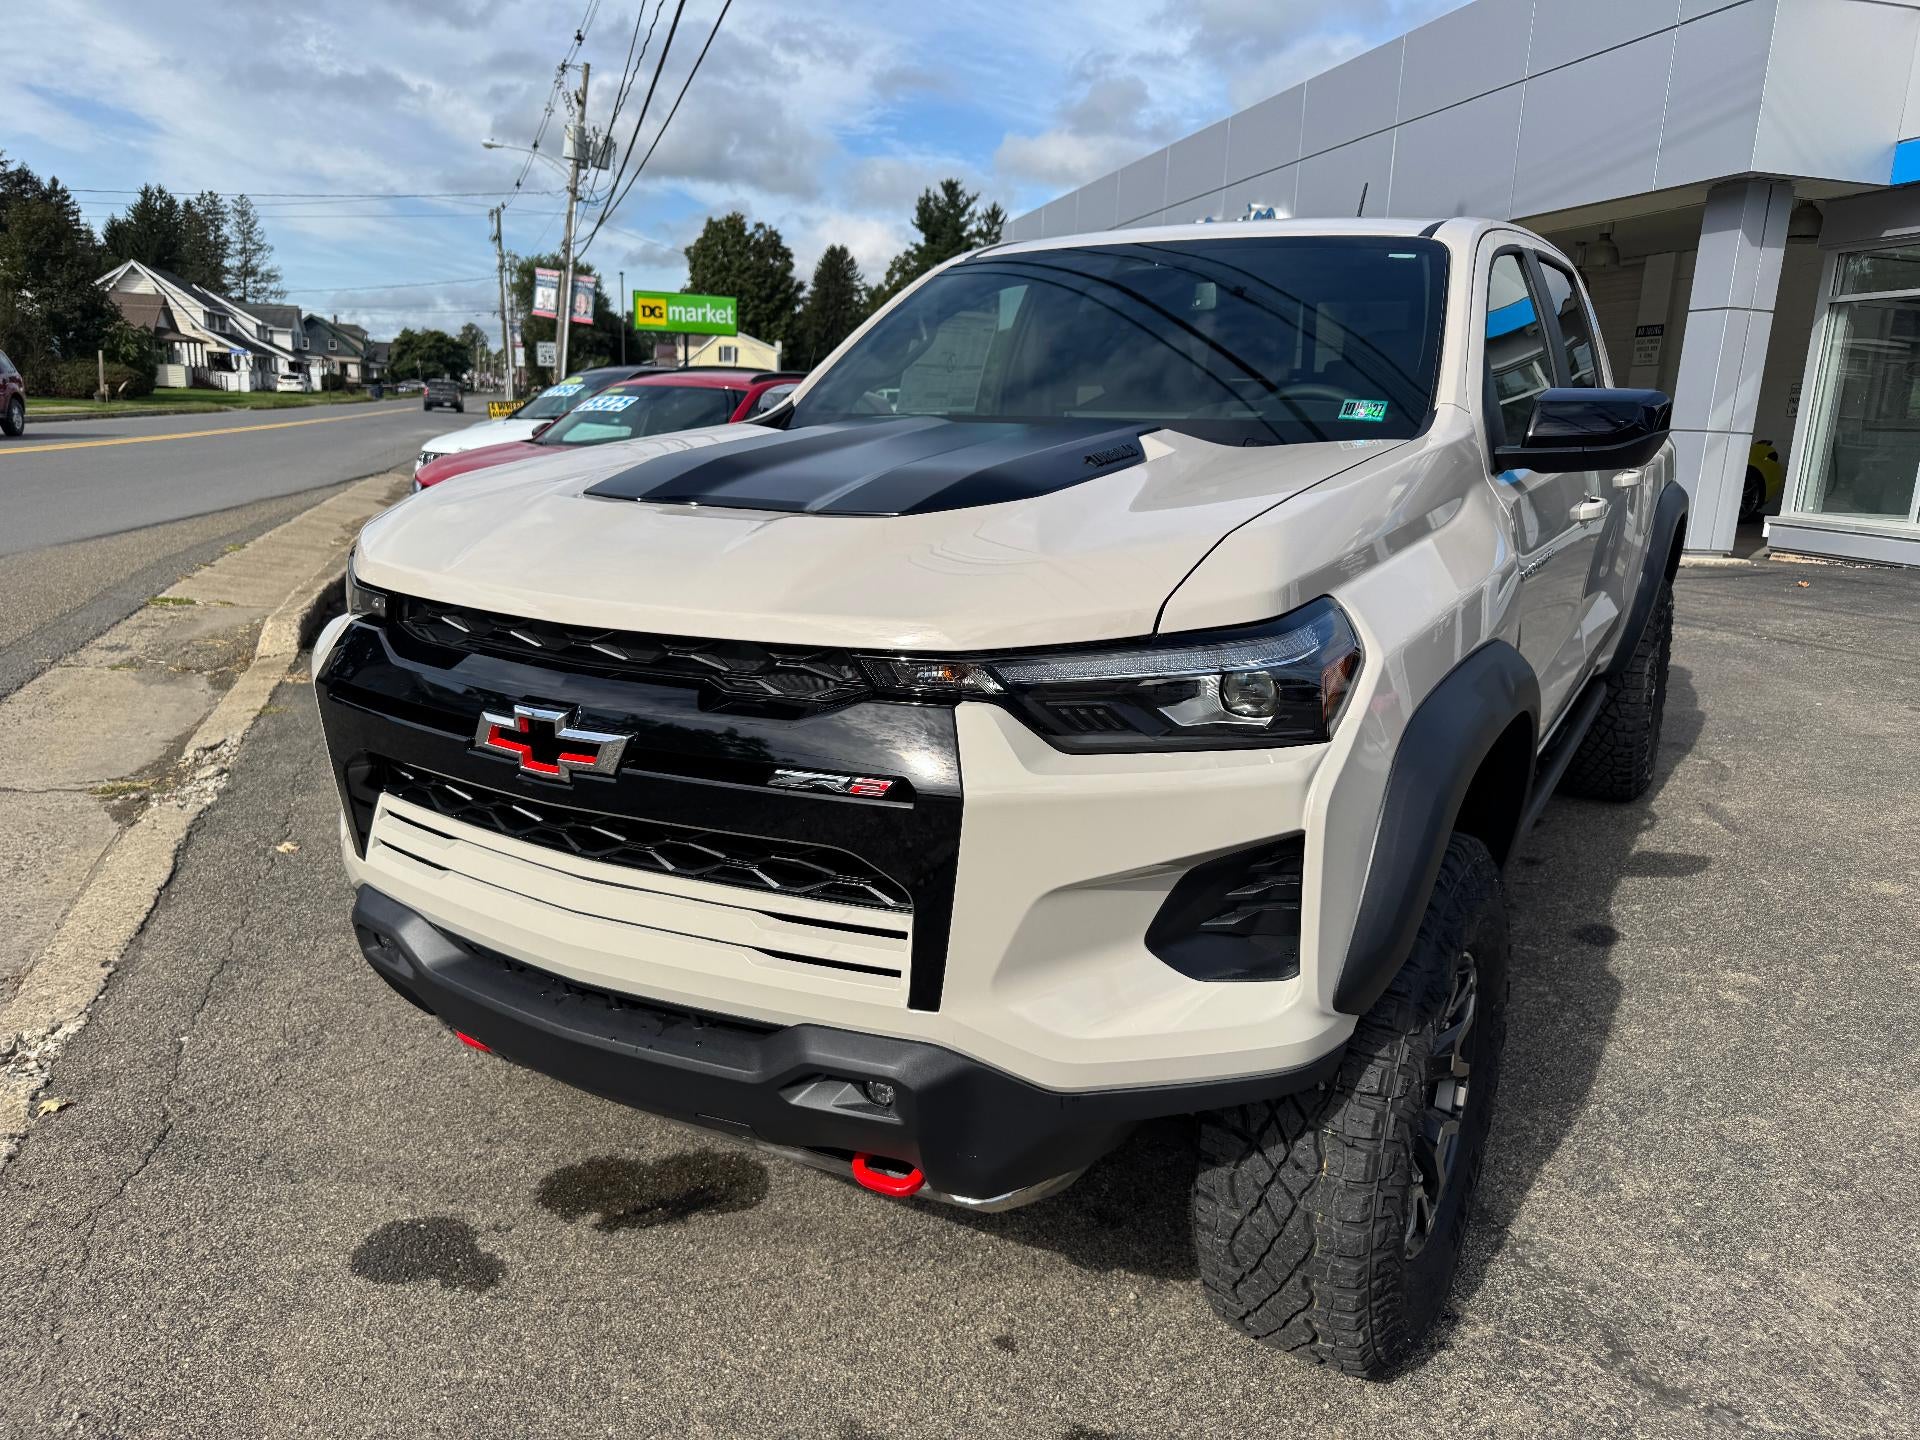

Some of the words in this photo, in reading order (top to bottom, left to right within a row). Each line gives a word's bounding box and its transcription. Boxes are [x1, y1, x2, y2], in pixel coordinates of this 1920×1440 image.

[641, 304, 664, 319] DG
[668, 303, 735, 324] market
[540, 354, 555, 364] 35
[767, 769, 896, 797] ZR2
